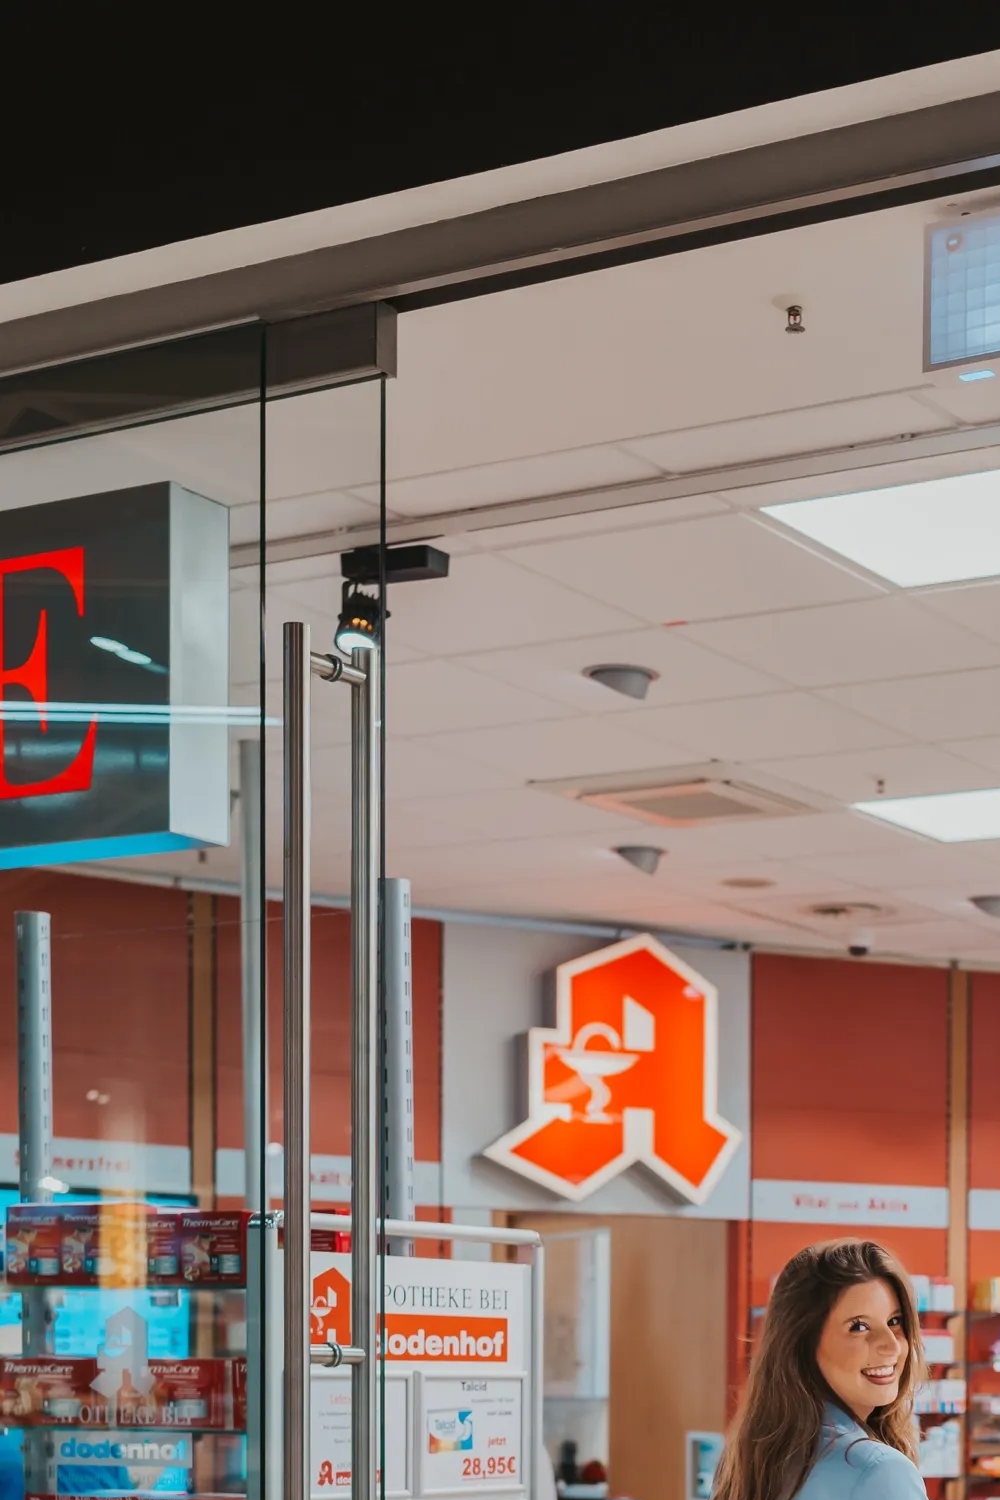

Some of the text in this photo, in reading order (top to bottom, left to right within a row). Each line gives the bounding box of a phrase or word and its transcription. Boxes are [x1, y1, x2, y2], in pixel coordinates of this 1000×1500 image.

[182, 1218, 239, 1228] ThermaCare
[480, 1288, 508, 1310] BEI
[4, 1362, 73, 1374] ThermaCare
[461, 1381, 487, 1392] Talcid
[488, 1436, 507, 1449] jetzt
[462, 1456, 516, 1479] 28,95€
